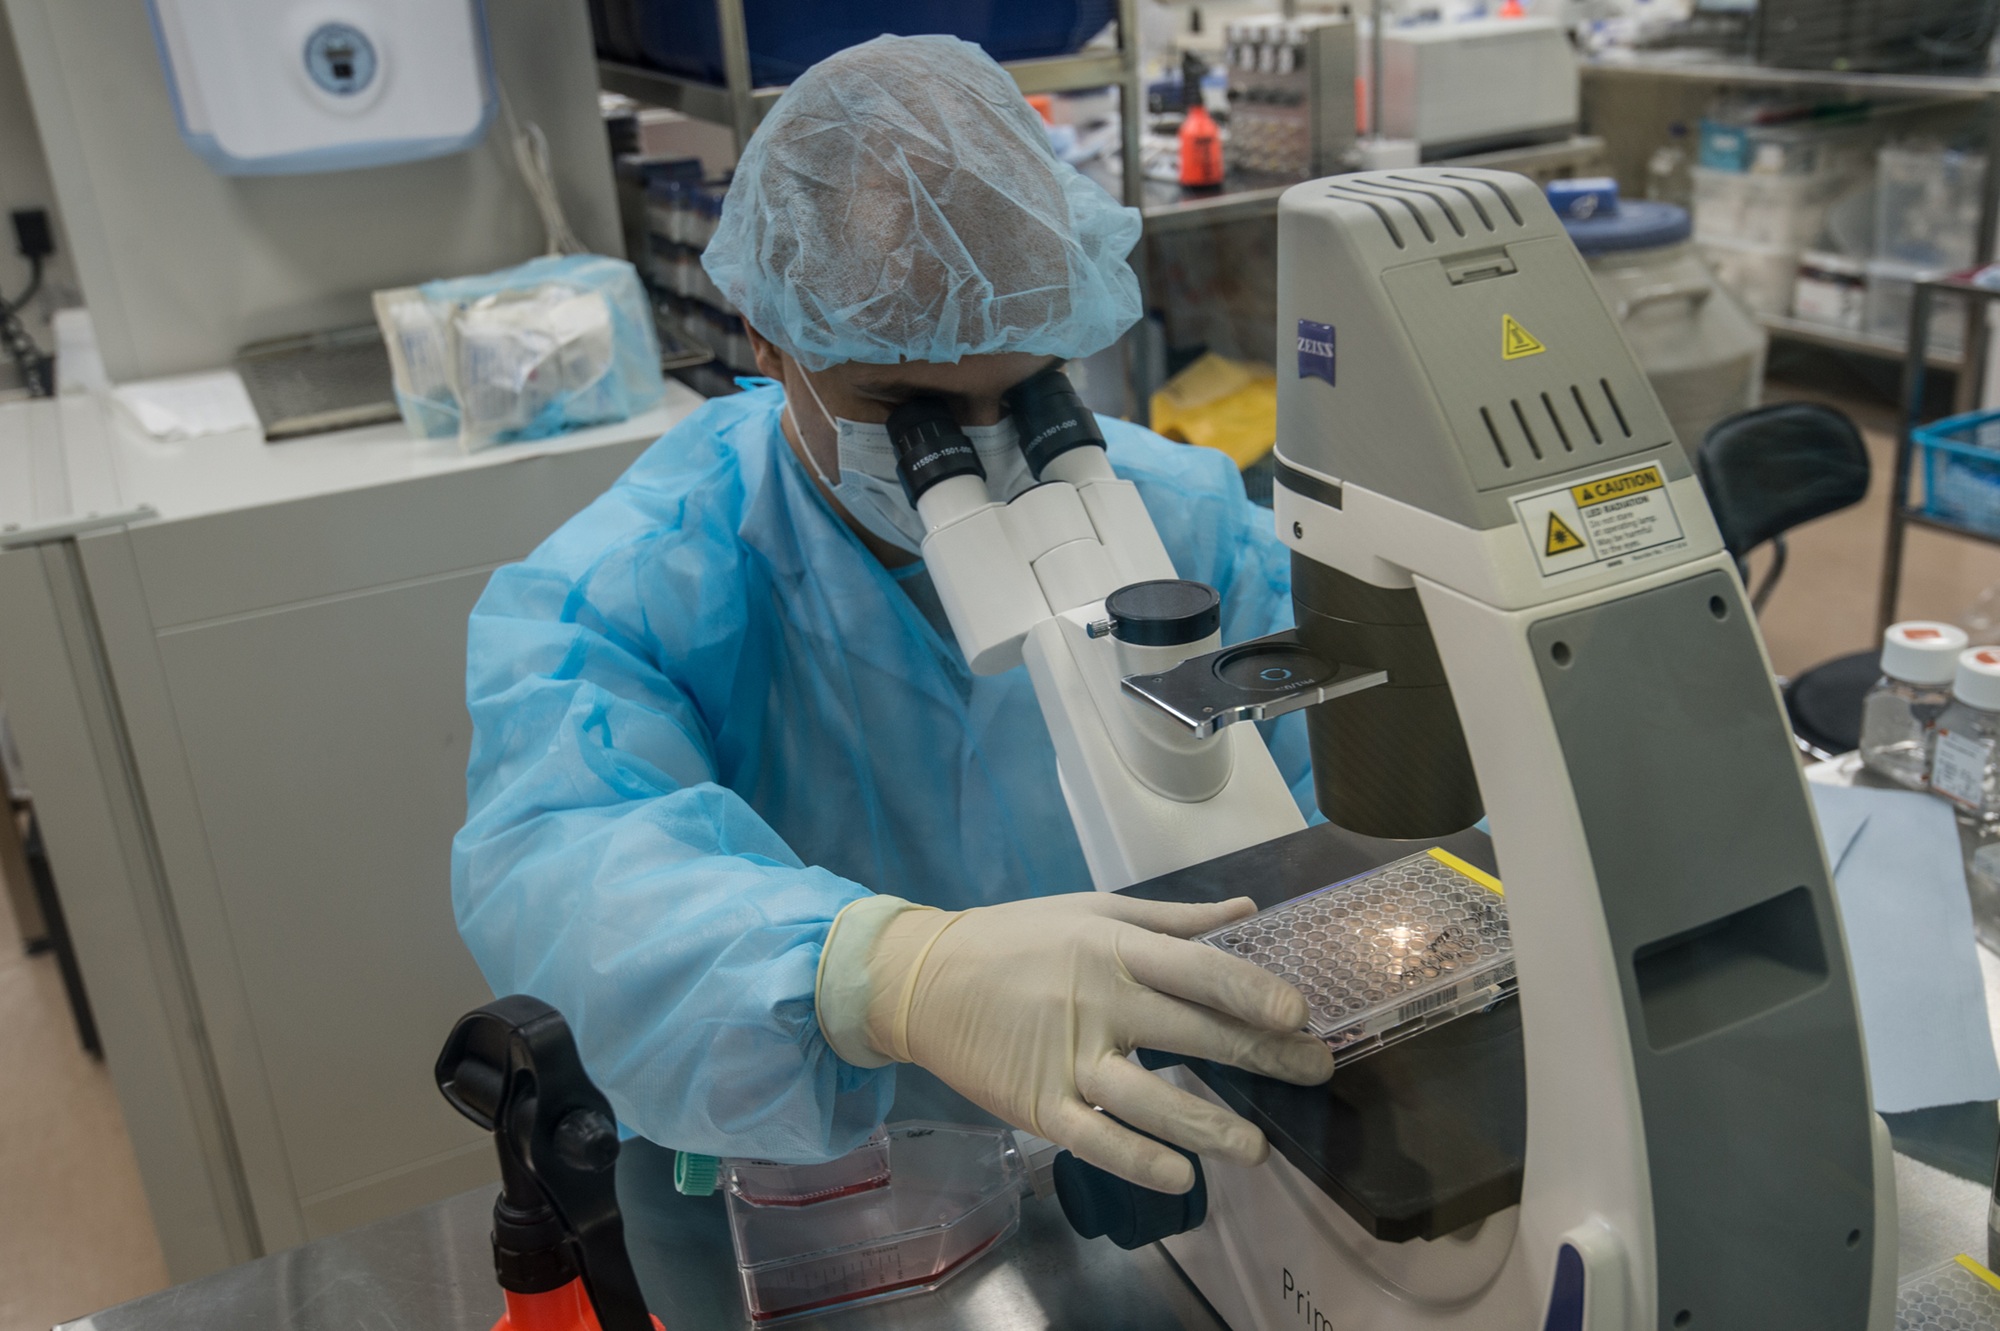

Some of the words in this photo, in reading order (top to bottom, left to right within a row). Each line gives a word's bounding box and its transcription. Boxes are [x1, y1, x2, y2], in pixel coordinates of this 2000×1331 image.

[1297, 336, 1334, 358] ZEISS
[1595, 472, 1656, 496] CAUTION
[1604, 495, 1649, 513] RADIATION
